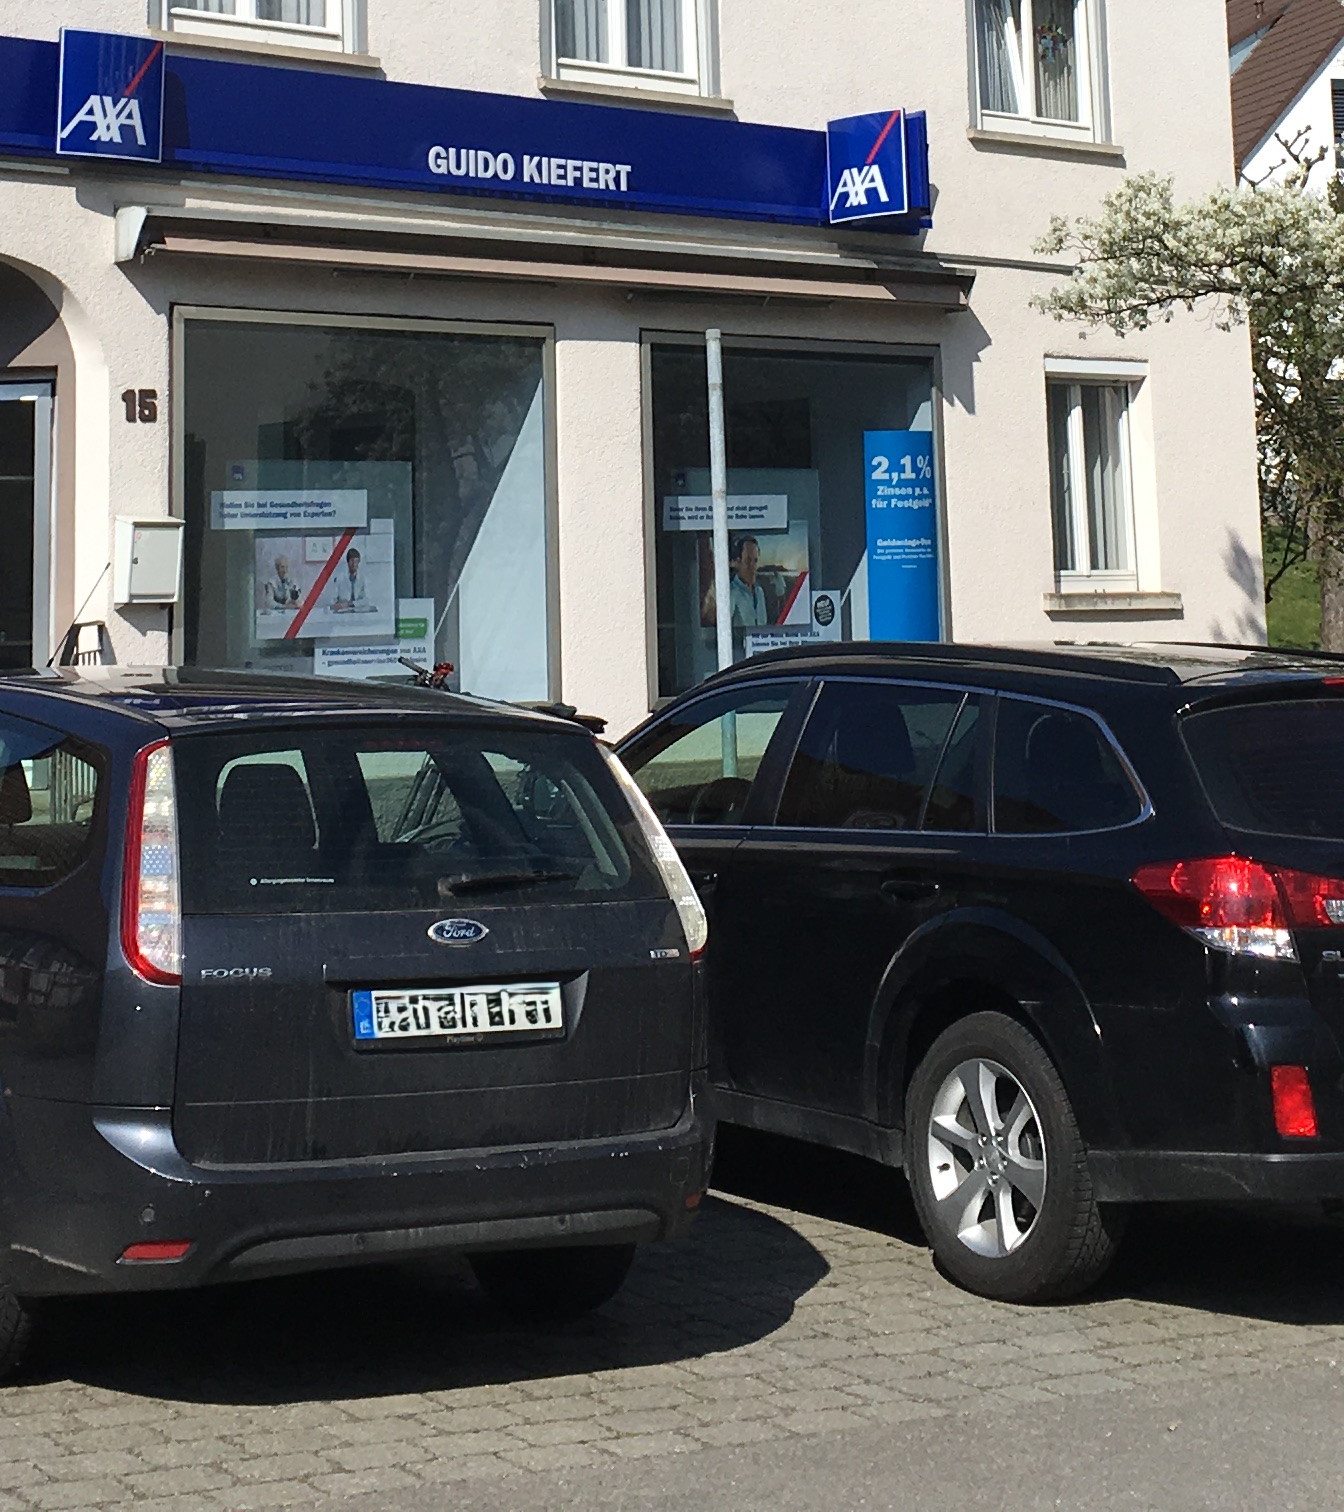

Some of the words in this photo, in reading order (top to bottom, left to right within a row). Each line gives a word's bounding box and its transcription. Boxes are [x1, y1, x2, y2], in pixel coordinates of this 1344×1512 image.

[60, 94, 146, 146] AXA
[428, 145, 515, 180] GUIDO
[523, 154, 632, 192] KIEFERT
[830, 164, 890, 210] AXA
[121, 388, 158, 424] 15
[871, 454, 932, 485] 2,1%
[871, 498, 888, 508] für
[877, 485, 913, 495] Zinsen
[443, 922, 475, 938] Ford
[201, 967, 273, 979] FOCUS
